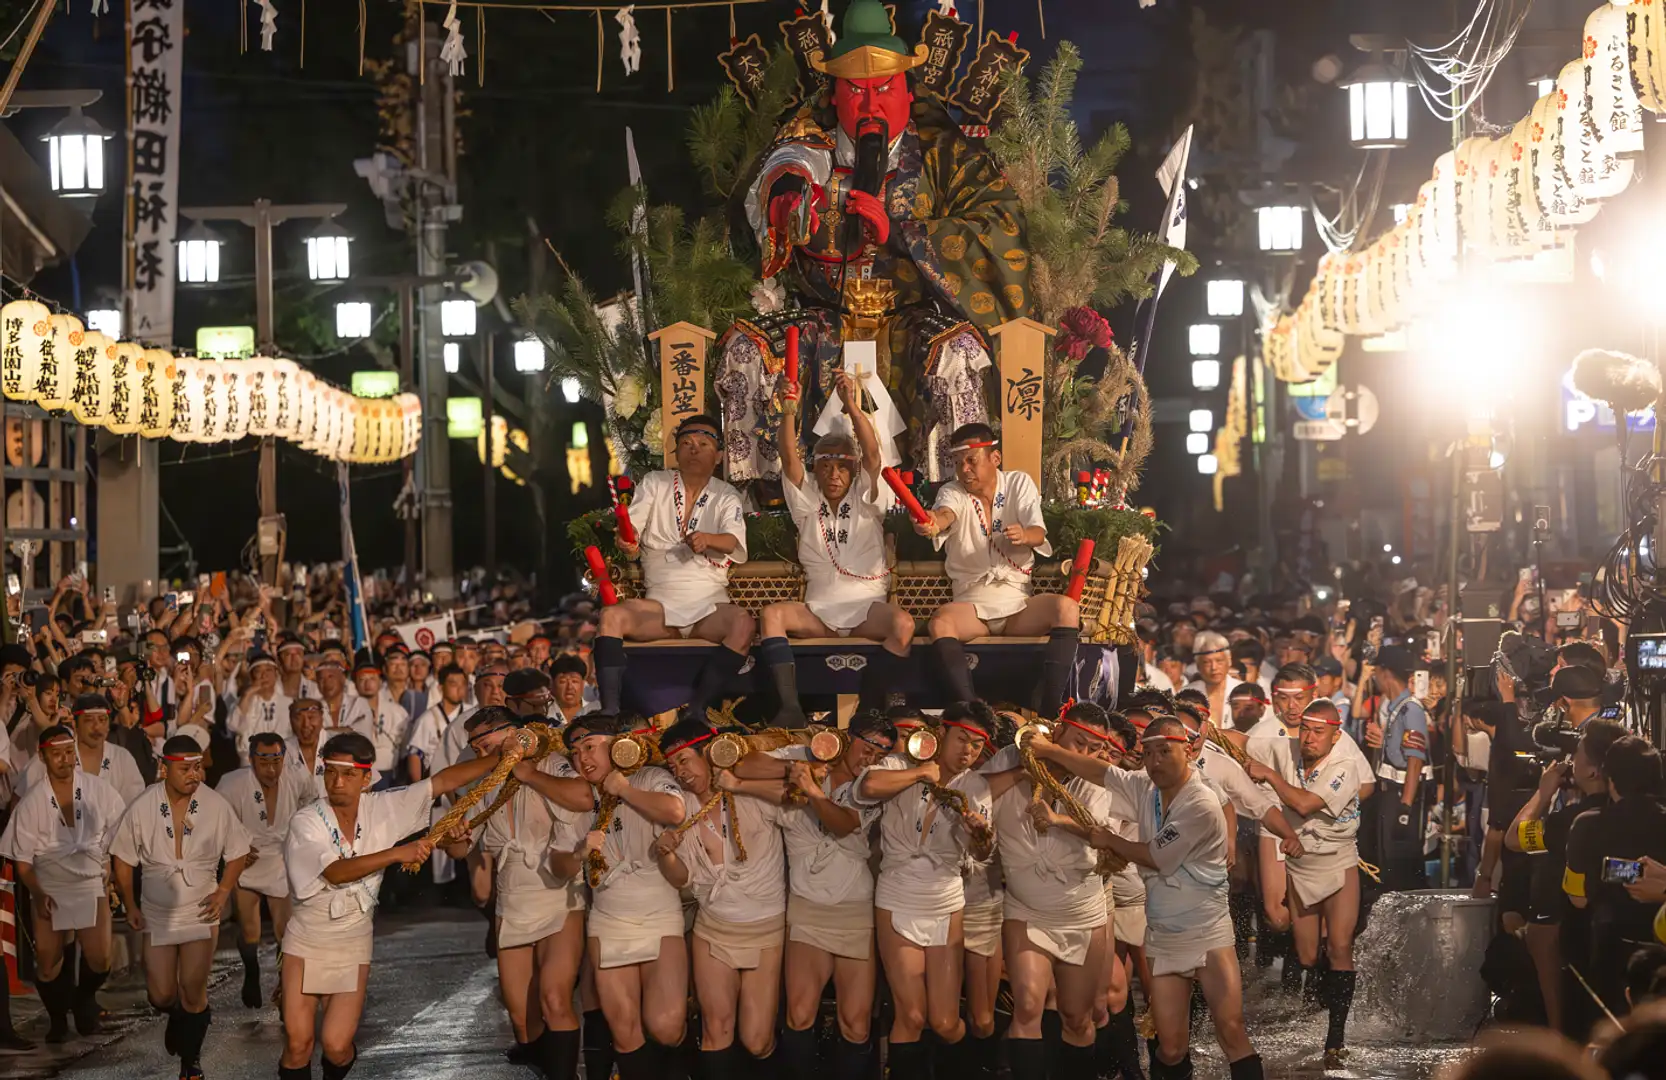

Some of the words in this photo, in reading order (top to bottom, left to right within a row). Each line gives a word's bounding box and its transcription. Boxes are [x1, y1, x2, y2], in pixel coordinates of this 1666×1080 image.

[4, 317, 24, 393] 博多祇園山笠
